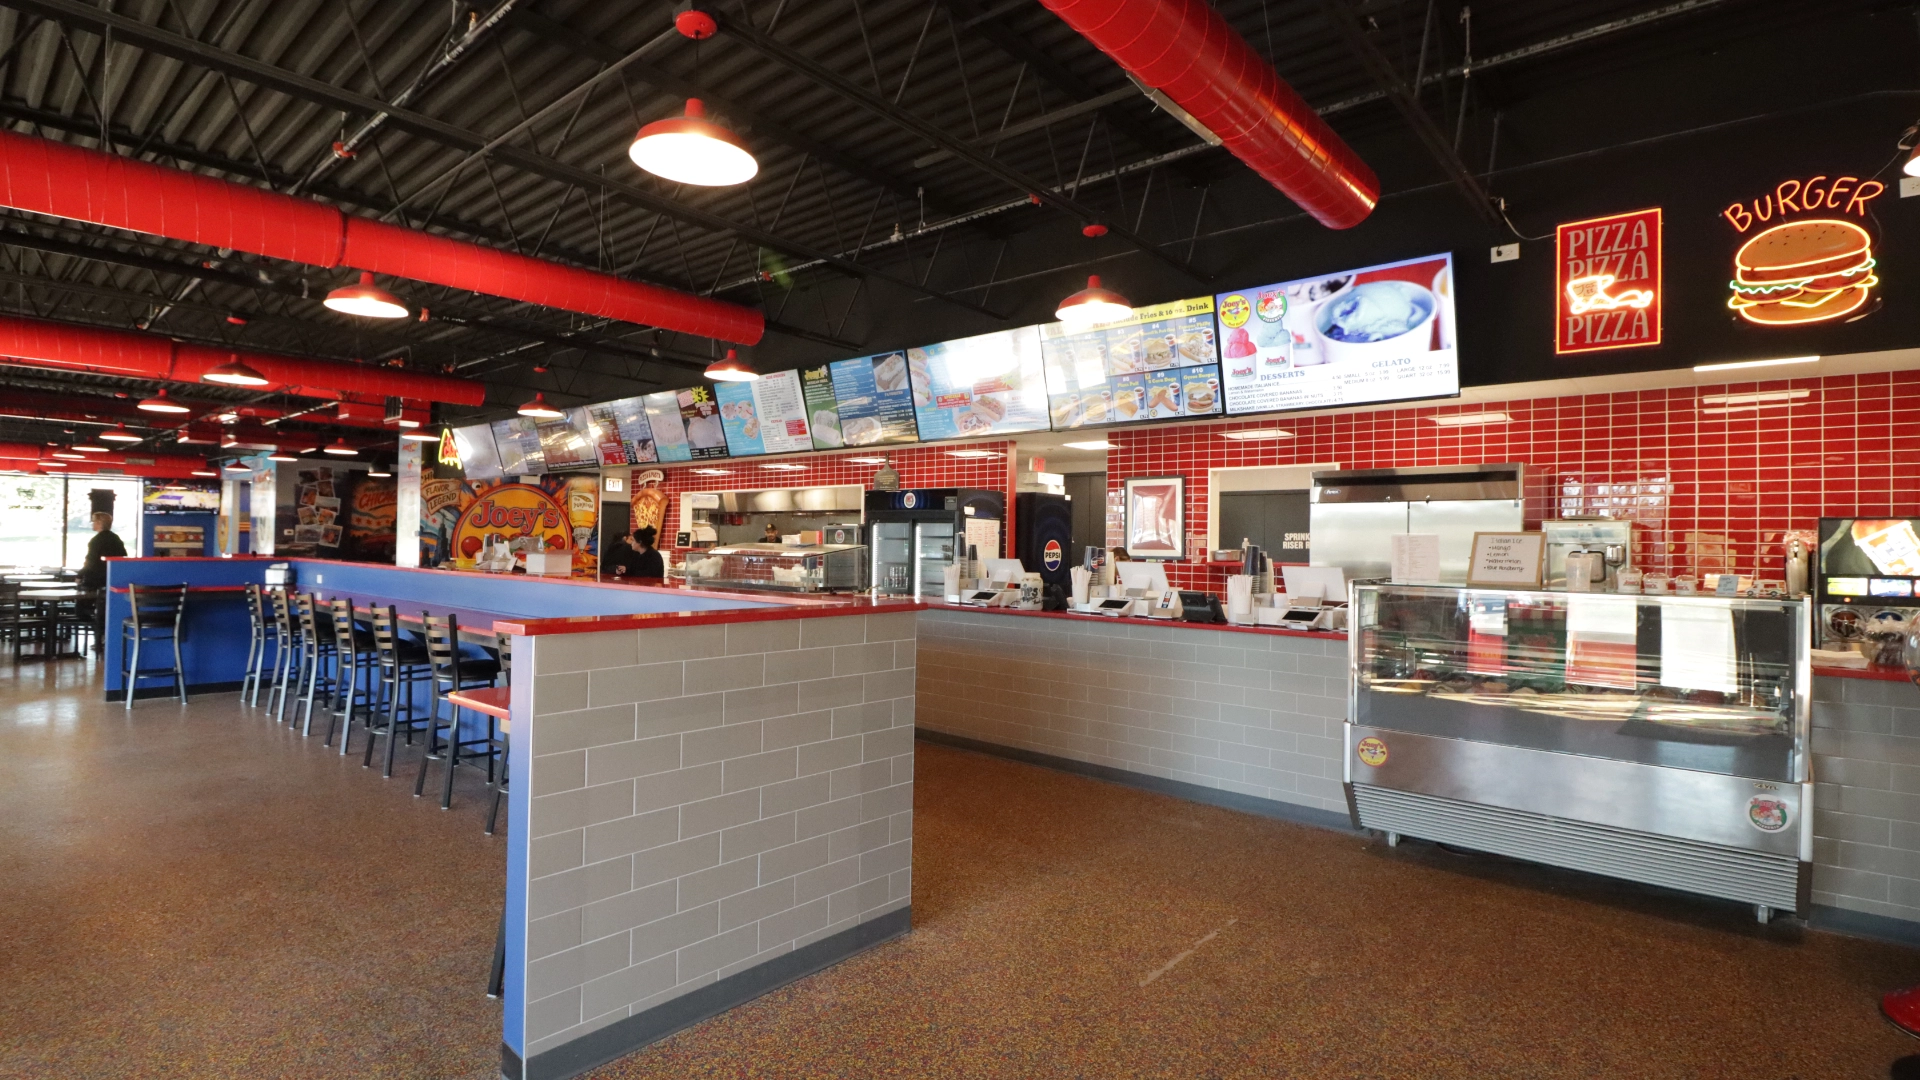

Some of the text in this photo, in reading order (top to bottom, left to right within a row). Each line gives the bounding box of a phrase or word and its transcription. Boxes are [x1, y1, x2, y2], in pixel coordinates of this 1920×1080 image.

[1723, 176, 1884, 232] BURGER
[1567, 220, 1648, 259] PIZZA
[1567, 250, 1648, 283] PIZZA
[1140, 312, 1157, 321] Fries
[1186, 302, 1209, 312] Drink
[1222, 298, 1246, 309] Joey's
[1566, 308, 1649, 346] PIZZA
[1371, 357, 1411, 369] GELATO
[1260, 370, 1305, 381] DESSERTS
[426, 484, 450, 496] FLAVOR
[430, 493, 457, 509] LEGEND
[471, 500, 559, 534] Joey's
[1283, 541, 1303, 549] RISER
